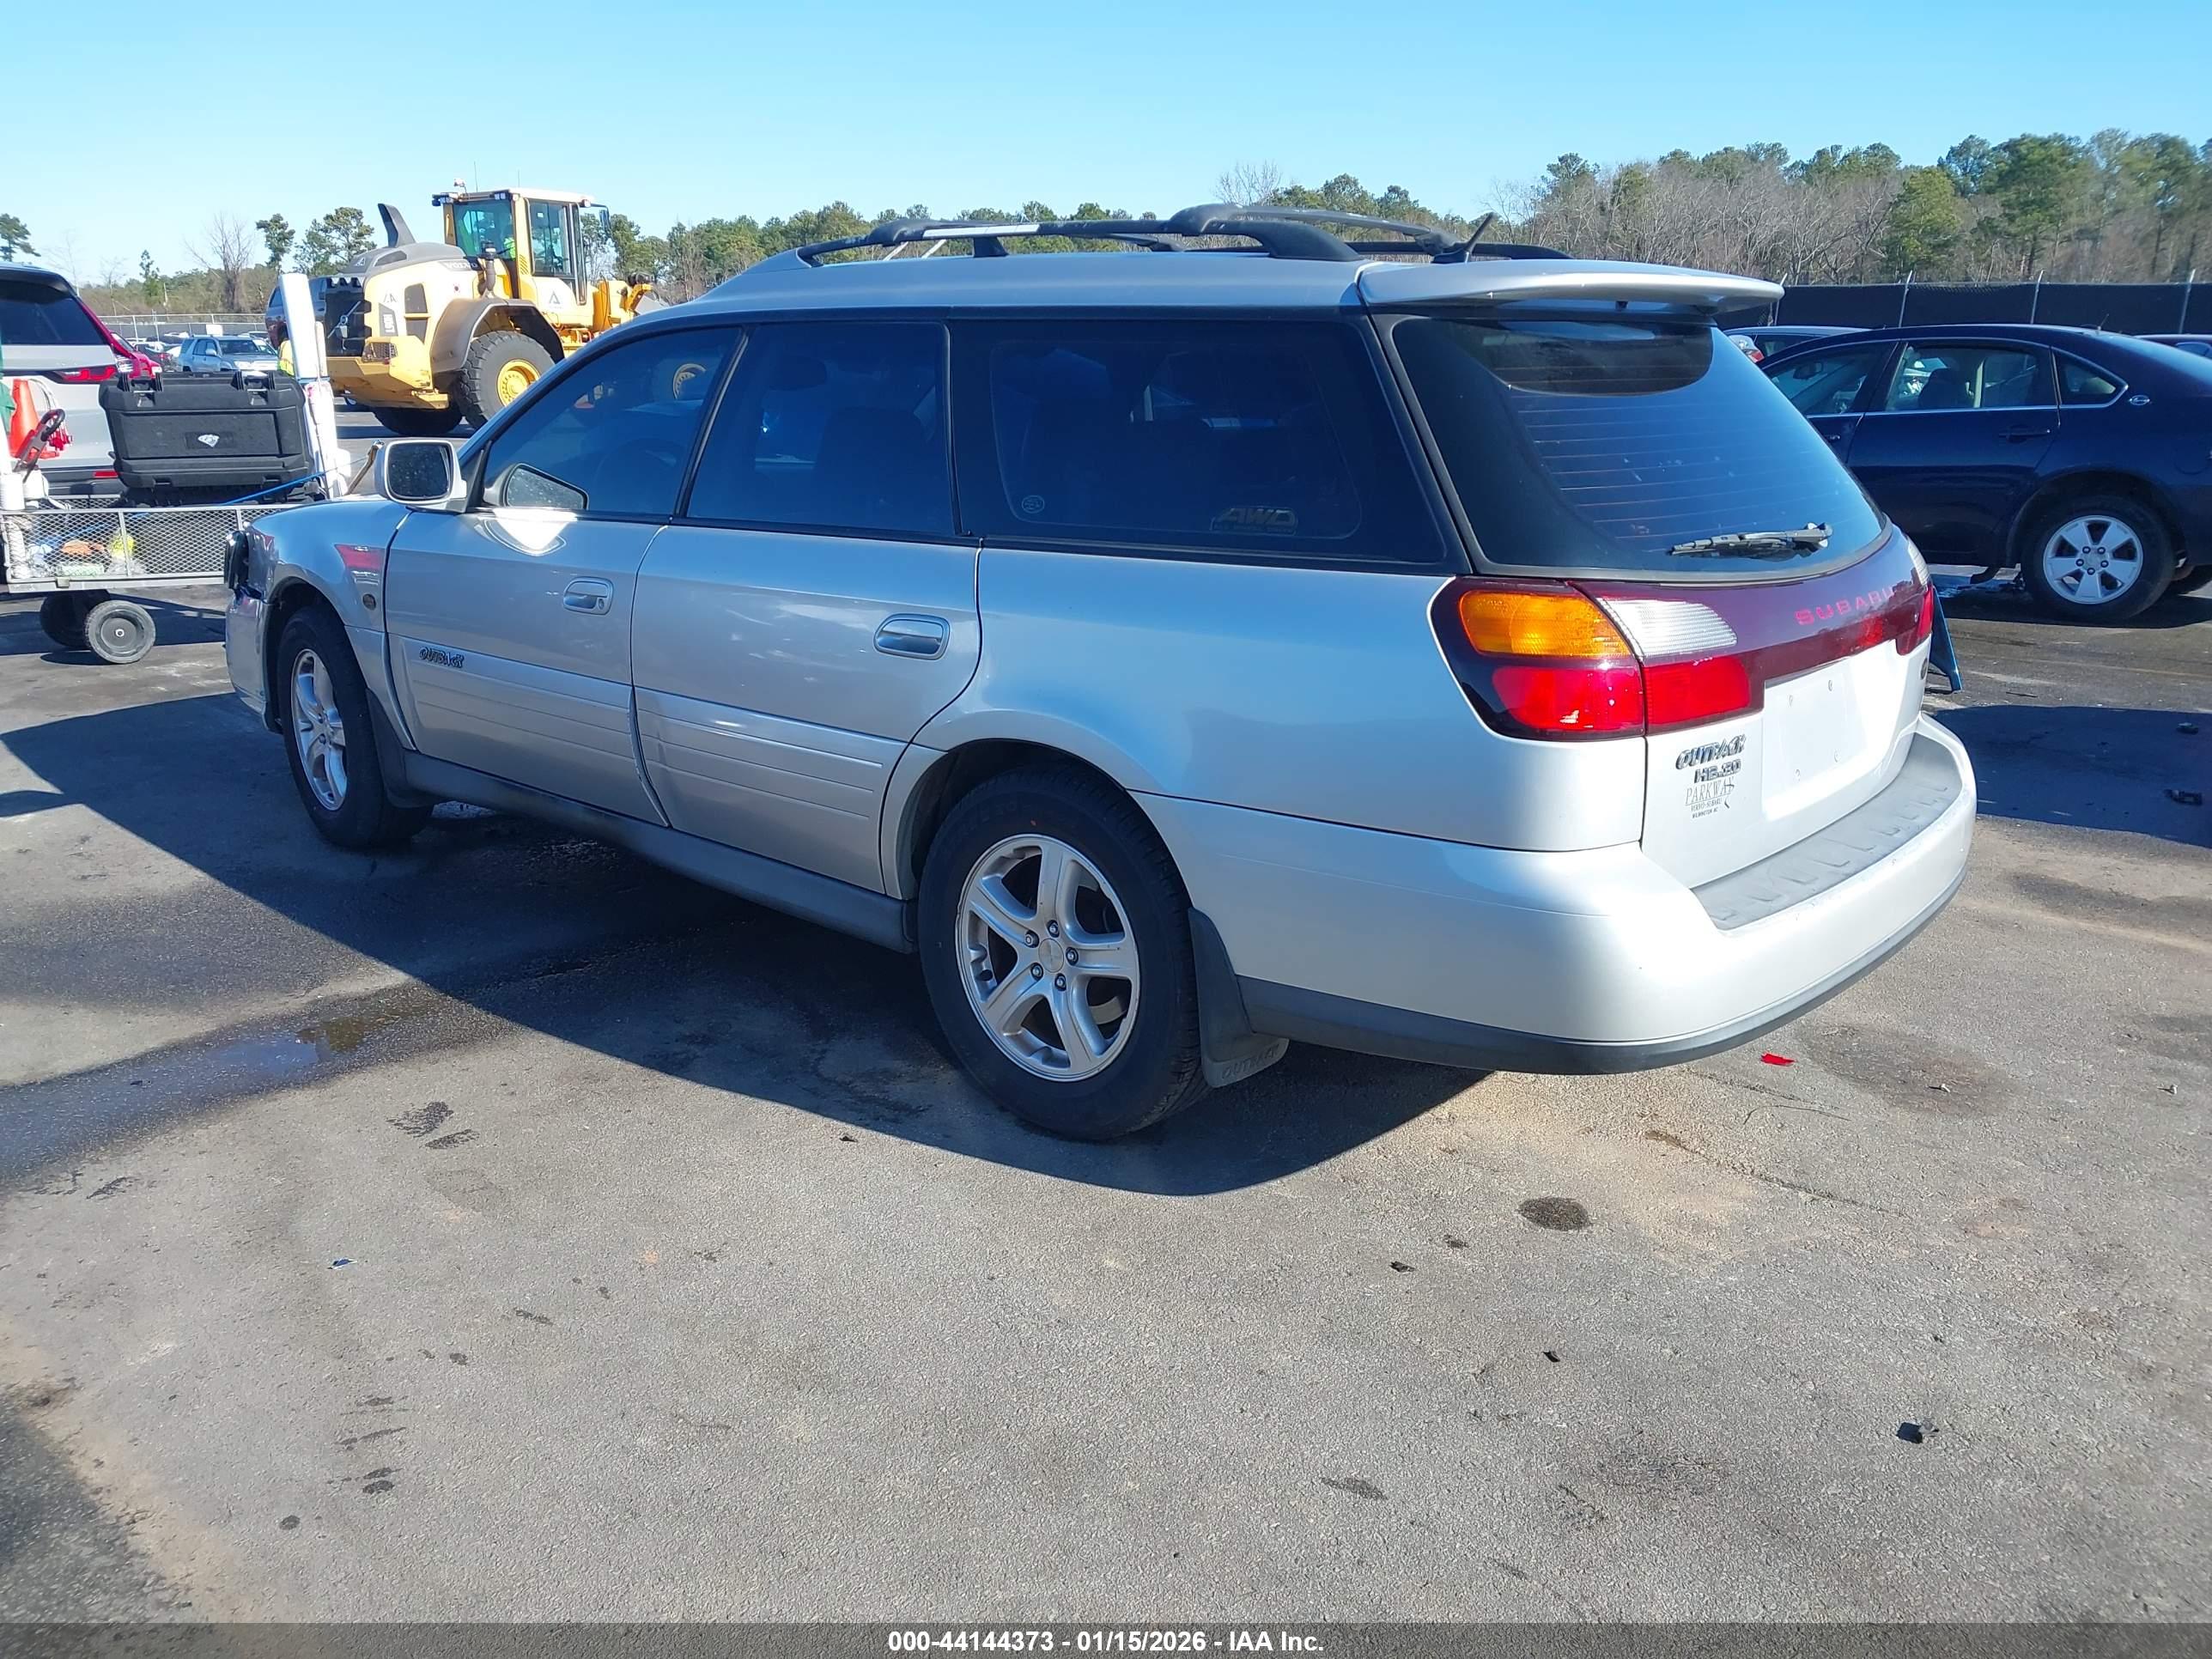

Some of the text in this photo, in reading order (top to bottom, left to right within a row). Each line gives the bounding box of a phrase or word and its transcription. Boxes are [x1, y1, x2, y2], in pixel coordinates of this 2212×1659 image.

[445, 261, 478, 270] VOLVO
[1213, 507, 1297, 526] AWD
[1795, 586, 1894, 626] SUBARU
[418, 647, 465, 668] OUTBACK
[1675, 733, 1746, 769] OUTBACK
[1686, 776, 1734, 805] PARKWAY
